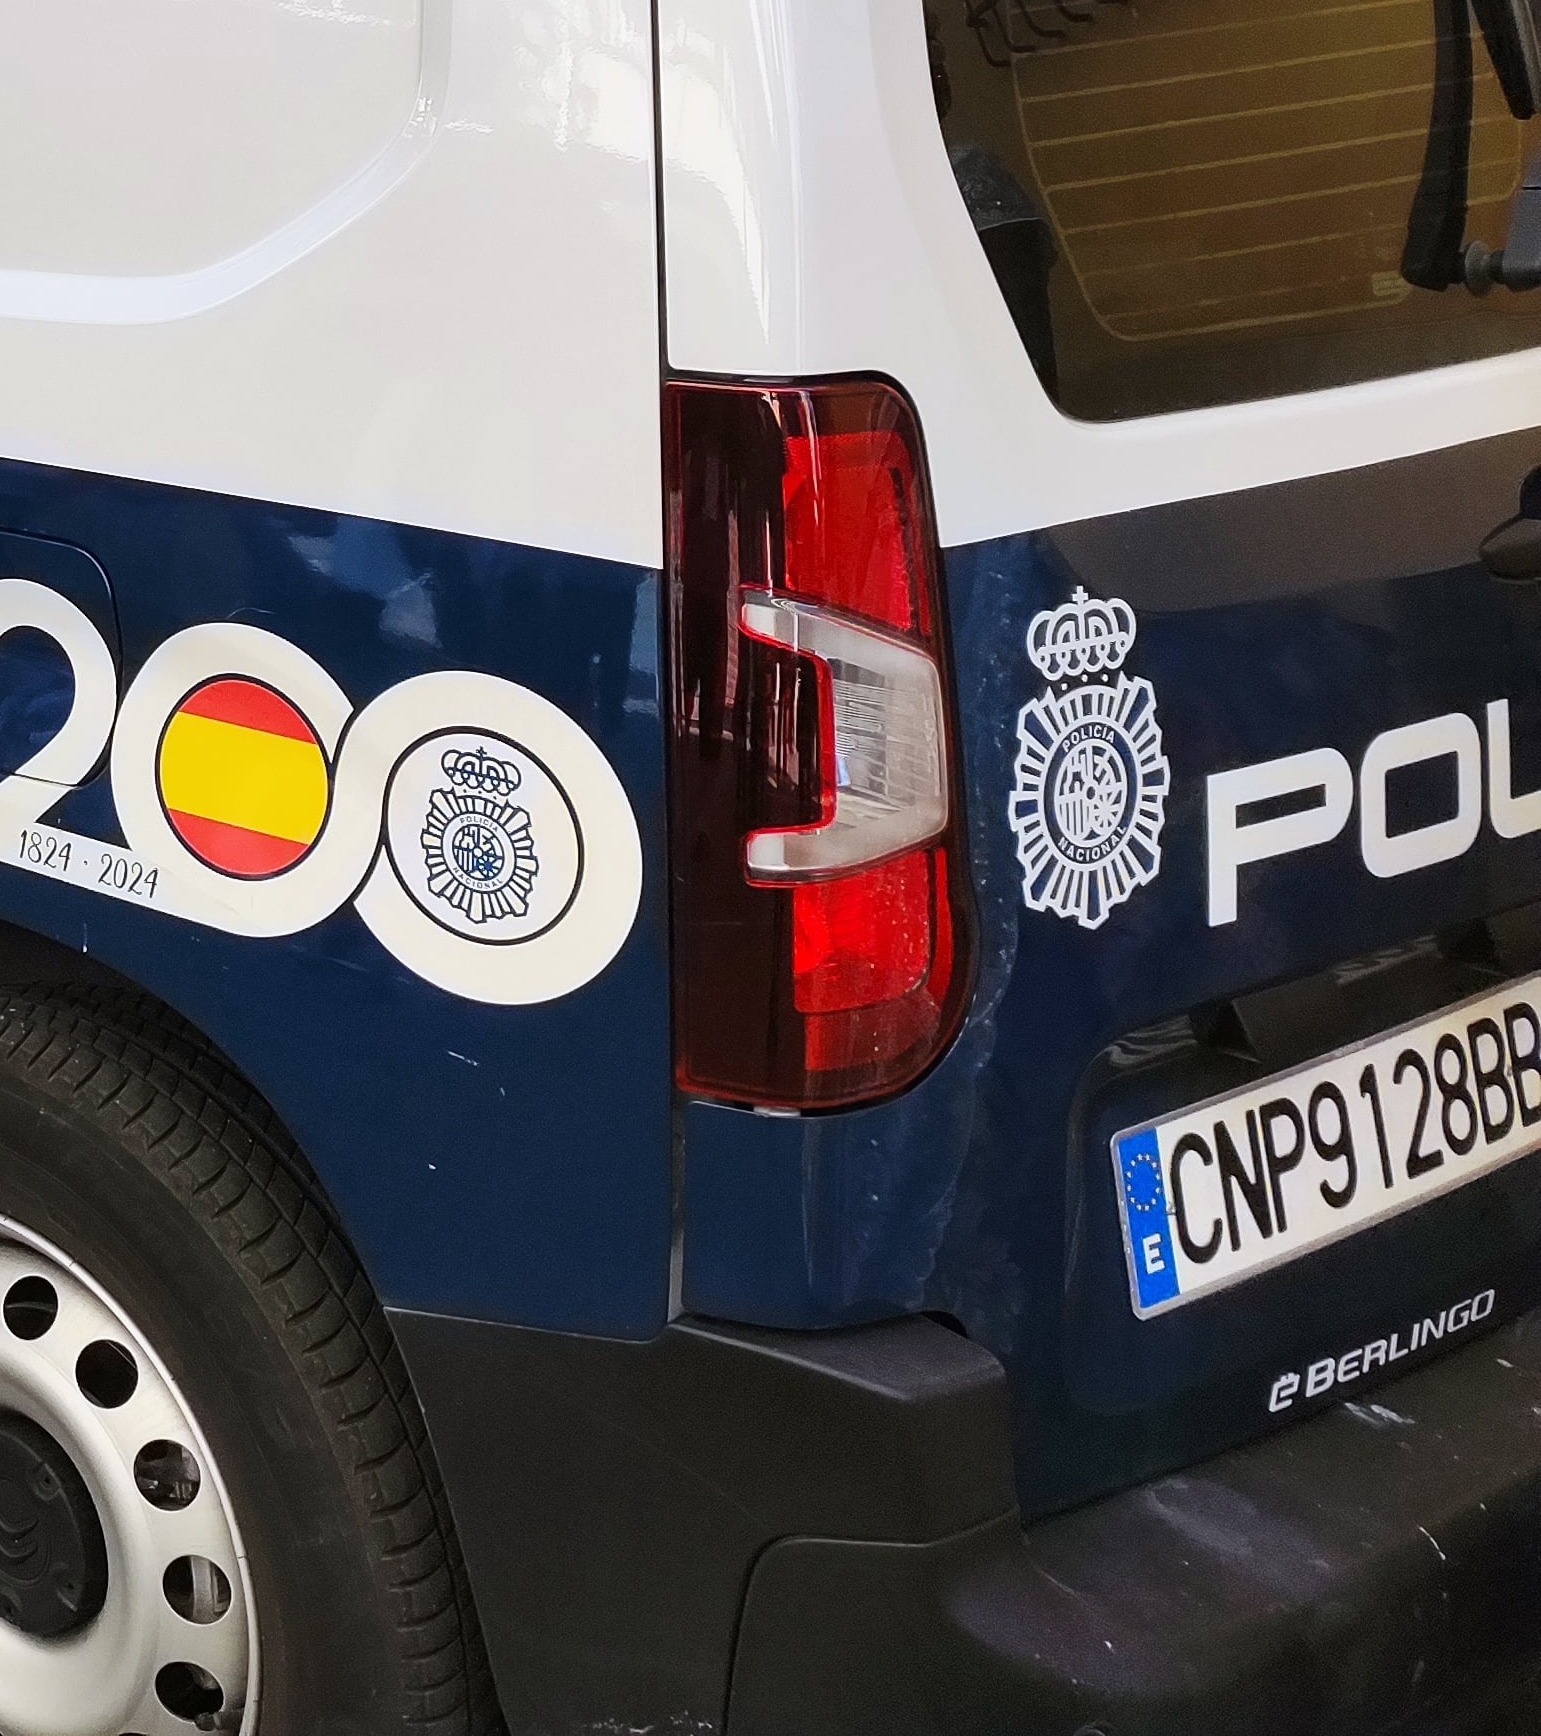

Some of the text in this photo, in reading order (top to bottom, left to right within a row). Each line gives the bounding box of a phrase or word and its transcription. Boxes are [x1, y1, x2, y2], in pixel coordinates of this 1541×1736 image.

[19, 829, 159, 899] 1824 2024
[1057, 826, 1127, 862] NACIONAL
[1142, 1233, 1166, 1274] E
[1304, 1288, 1496, 1398] BERLINGO
